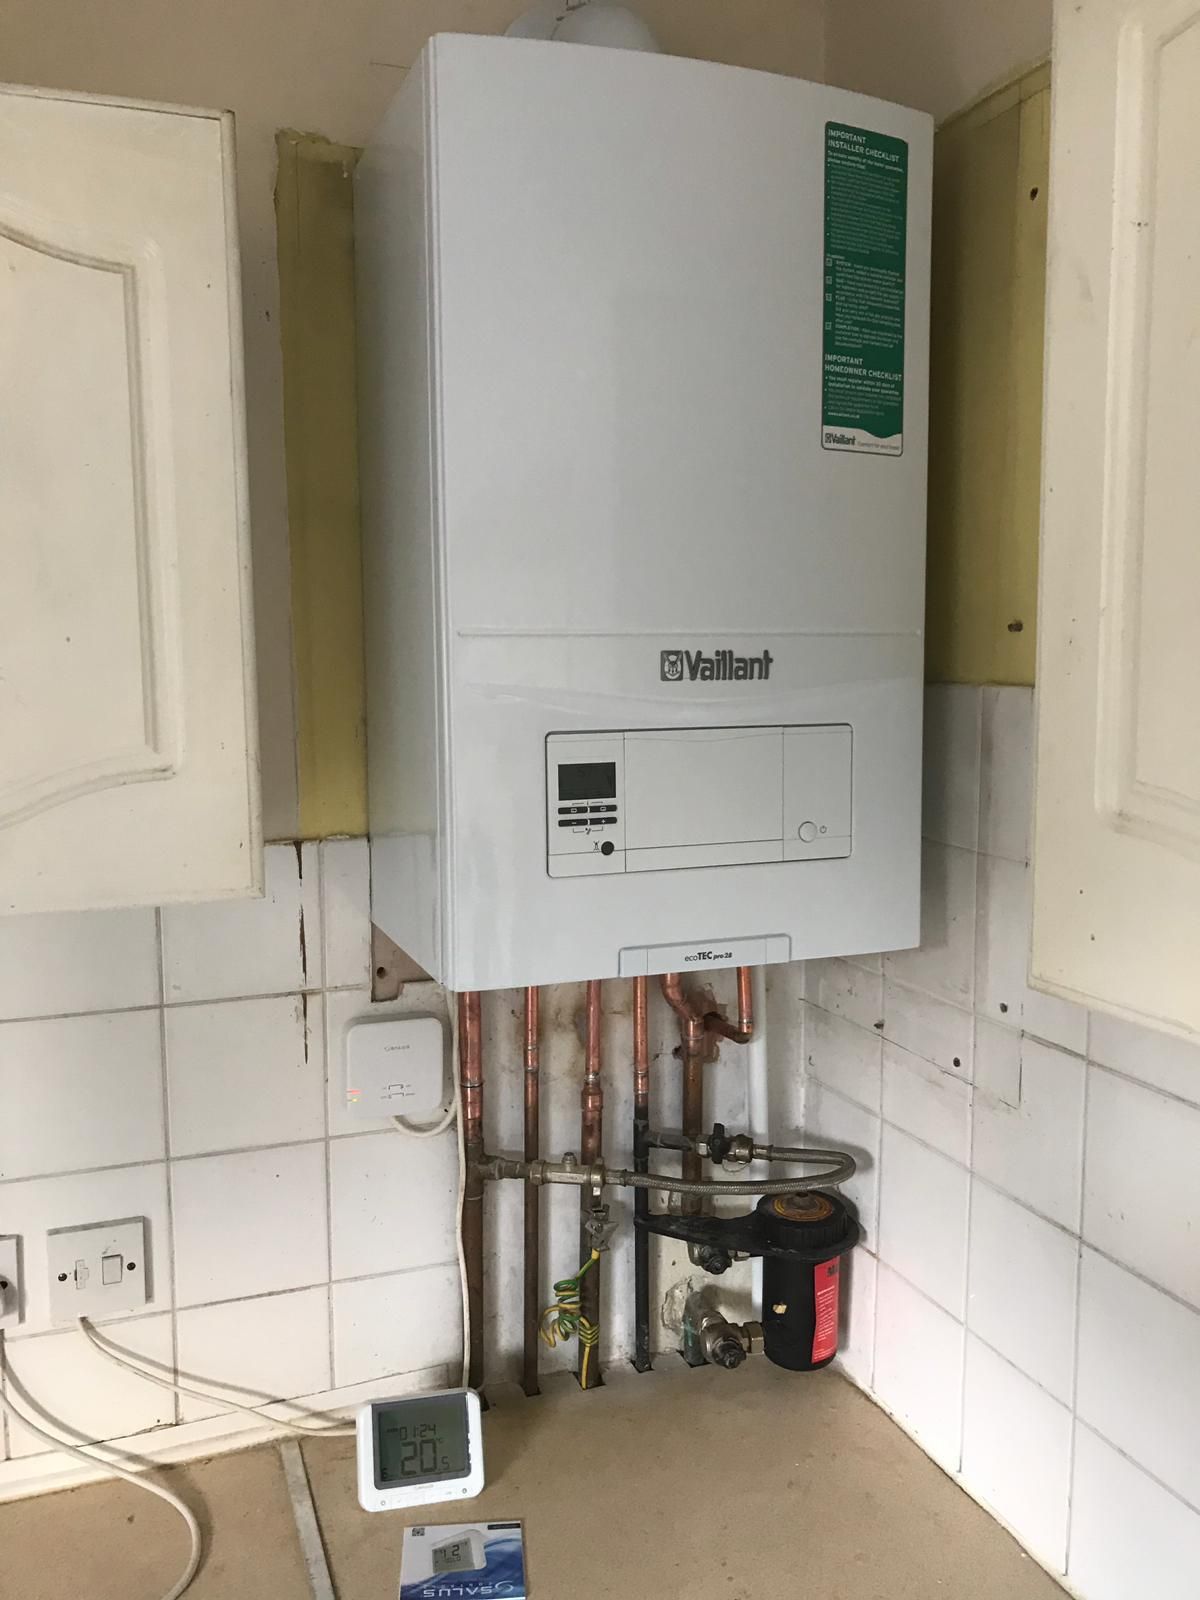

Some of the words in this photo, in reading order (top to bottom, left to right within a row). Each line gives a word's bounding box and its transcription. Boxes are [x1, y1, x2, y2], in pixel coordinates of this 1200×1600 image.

[828, 129, 866, 143] IMPORTANT
[828, 140, 864, 154] INSTALLER
[865, 148, 899, 162] CHECKLIST
[824, 353, 863, 365] IMPORTANT
[824, 364, 867, 376] HOMEOWNER
[868, 370, 902, 381] CHECKLIST
[831, 433, 856, 445] Vaillant
[684, 650, 774, 681] Vaillant
[684, 951, 712, 961] ecoTEC
[423, 1586, 492, 1598] SALUS
